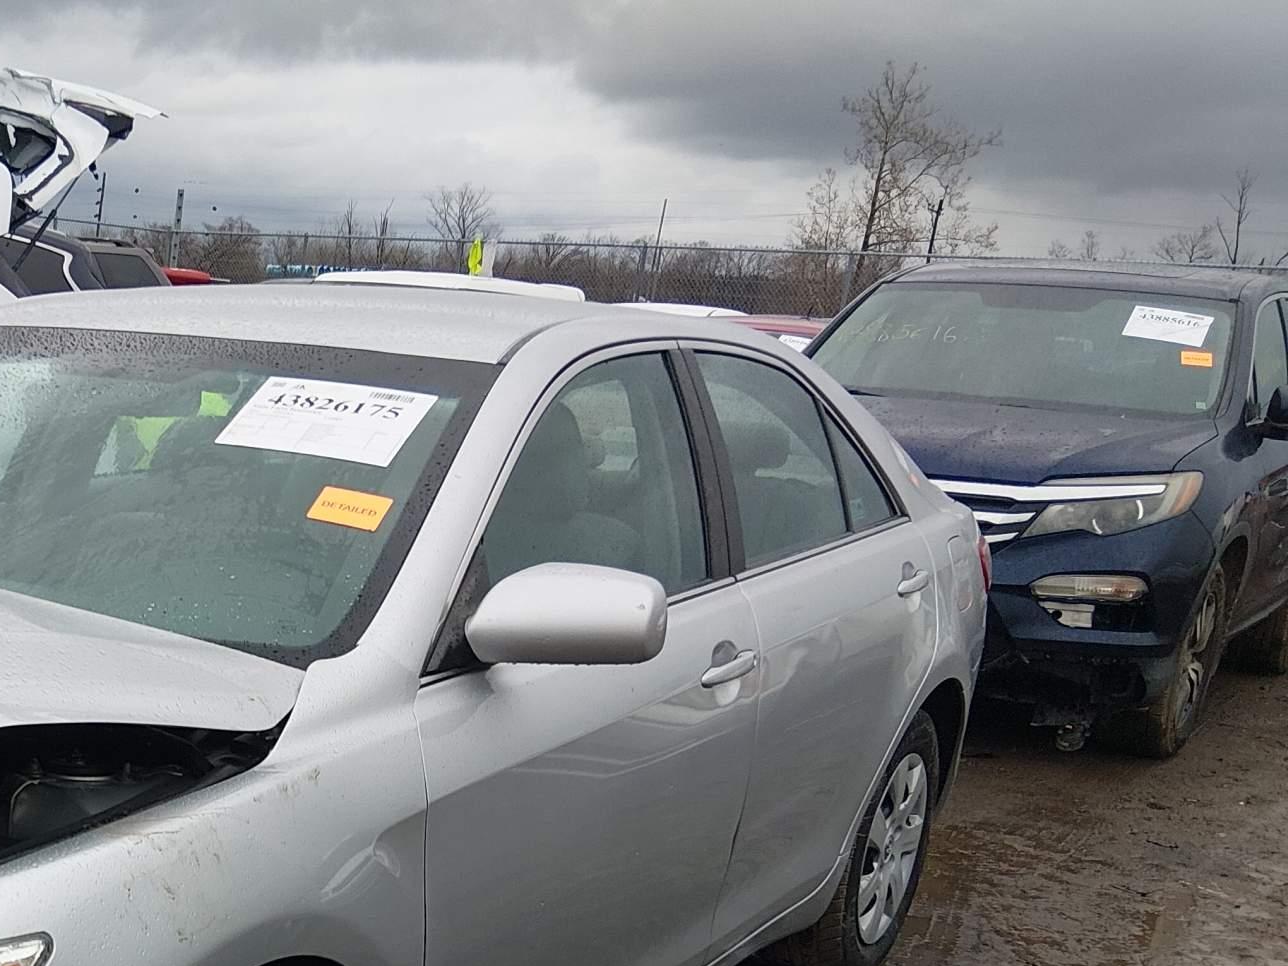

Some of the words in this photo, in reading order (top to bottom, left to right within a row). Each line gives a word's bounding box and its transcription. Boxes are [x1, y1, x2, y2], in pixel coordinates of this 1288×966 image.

[1139, 313, 1200, 328] 43885616
[268, 393, 403, 420] 43826175
[320, 500, 378, 517] DETAILED
